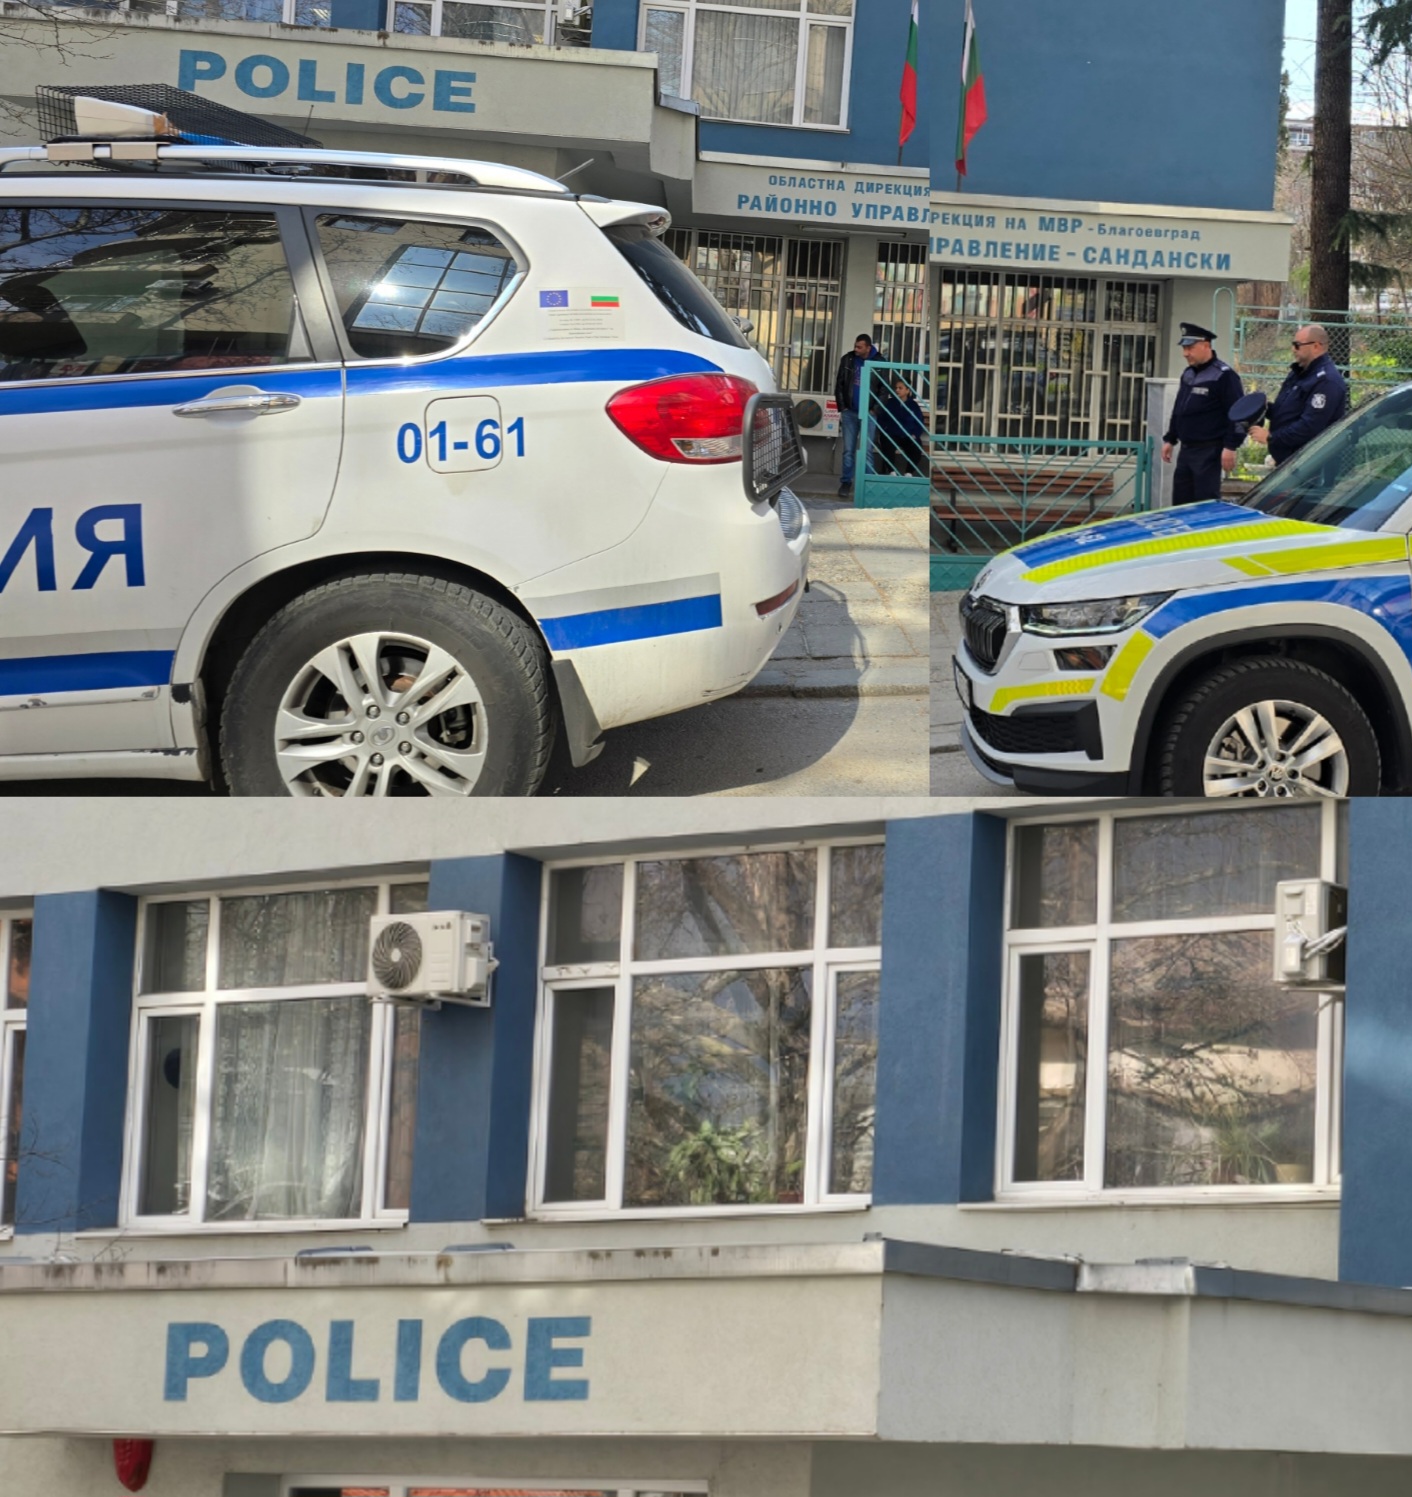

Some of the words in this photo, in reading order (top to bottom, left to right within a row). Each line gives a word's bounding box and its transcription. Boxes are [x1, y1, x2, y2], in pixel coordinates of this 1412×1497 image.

[177, 48, 477, 114] POLICE
[737, 193, 837, 217] РАЙОННО
[768, 174, 846, 192] ОБЛАСТНА
[854, 181, 930, 198] ДИРЕКЦИЯ
[930, 211, 996, 229] РЕКЦИЯ
[1005, 217, 1027, 231] НА
[1038, 216, 1083, 234] МВР
[1097, 223, 1201, 241] Благоевград
[1083, 246, 1231, 271] САНДАНСКИ
[397, 416, 525, 464] 01-61
[0, 503, 146, 594] ИЯ
[163, 1315, 593, 1403] POLICE
